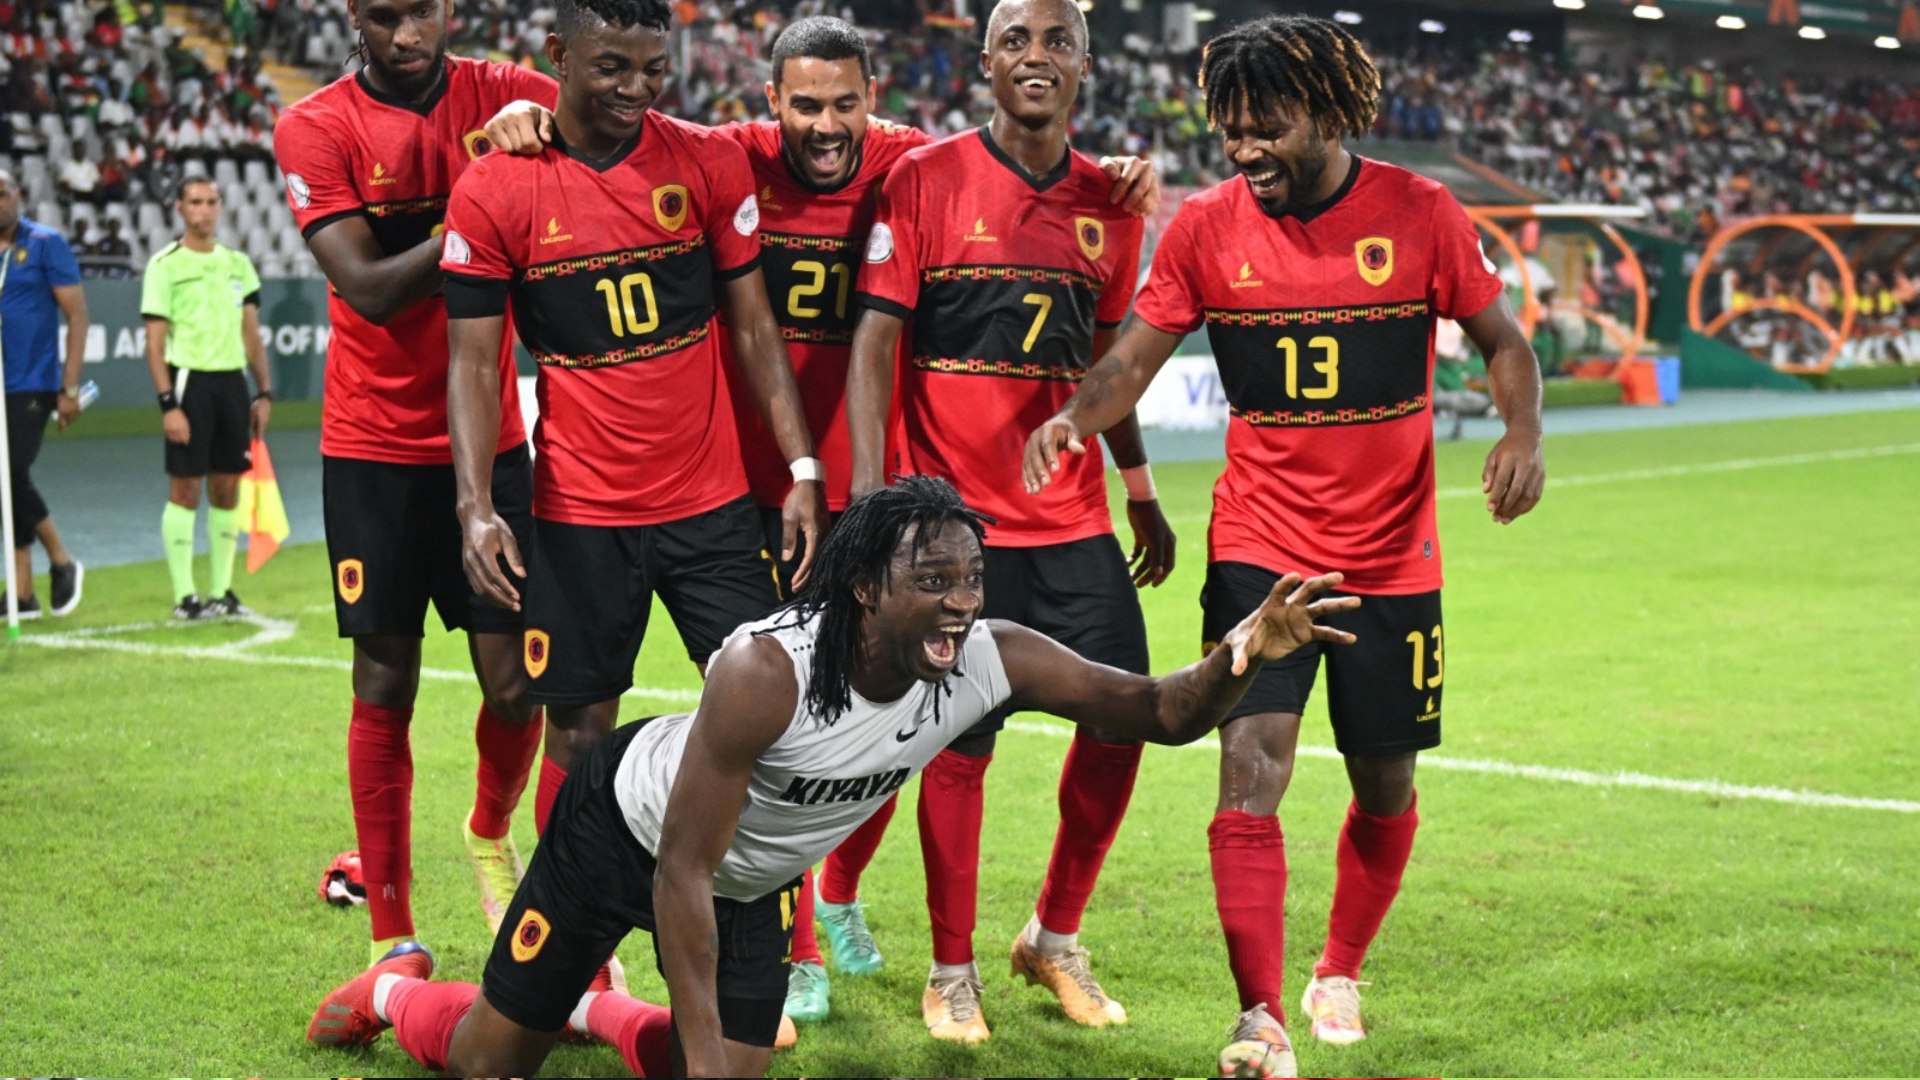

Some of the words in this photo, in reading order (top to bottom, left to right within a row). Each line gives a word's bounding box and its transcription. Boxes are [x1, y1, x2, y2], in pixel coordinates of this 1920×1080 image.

[595, 272, 660, 338] 10
[787, 260, 850, 320] 21
[1022, 293, 1053, 354] 7
[1276, 335, 1339, 400] 13
[1406, 624, 1443, 691] 13
[779, 767, 911, 805] KIYAYA
